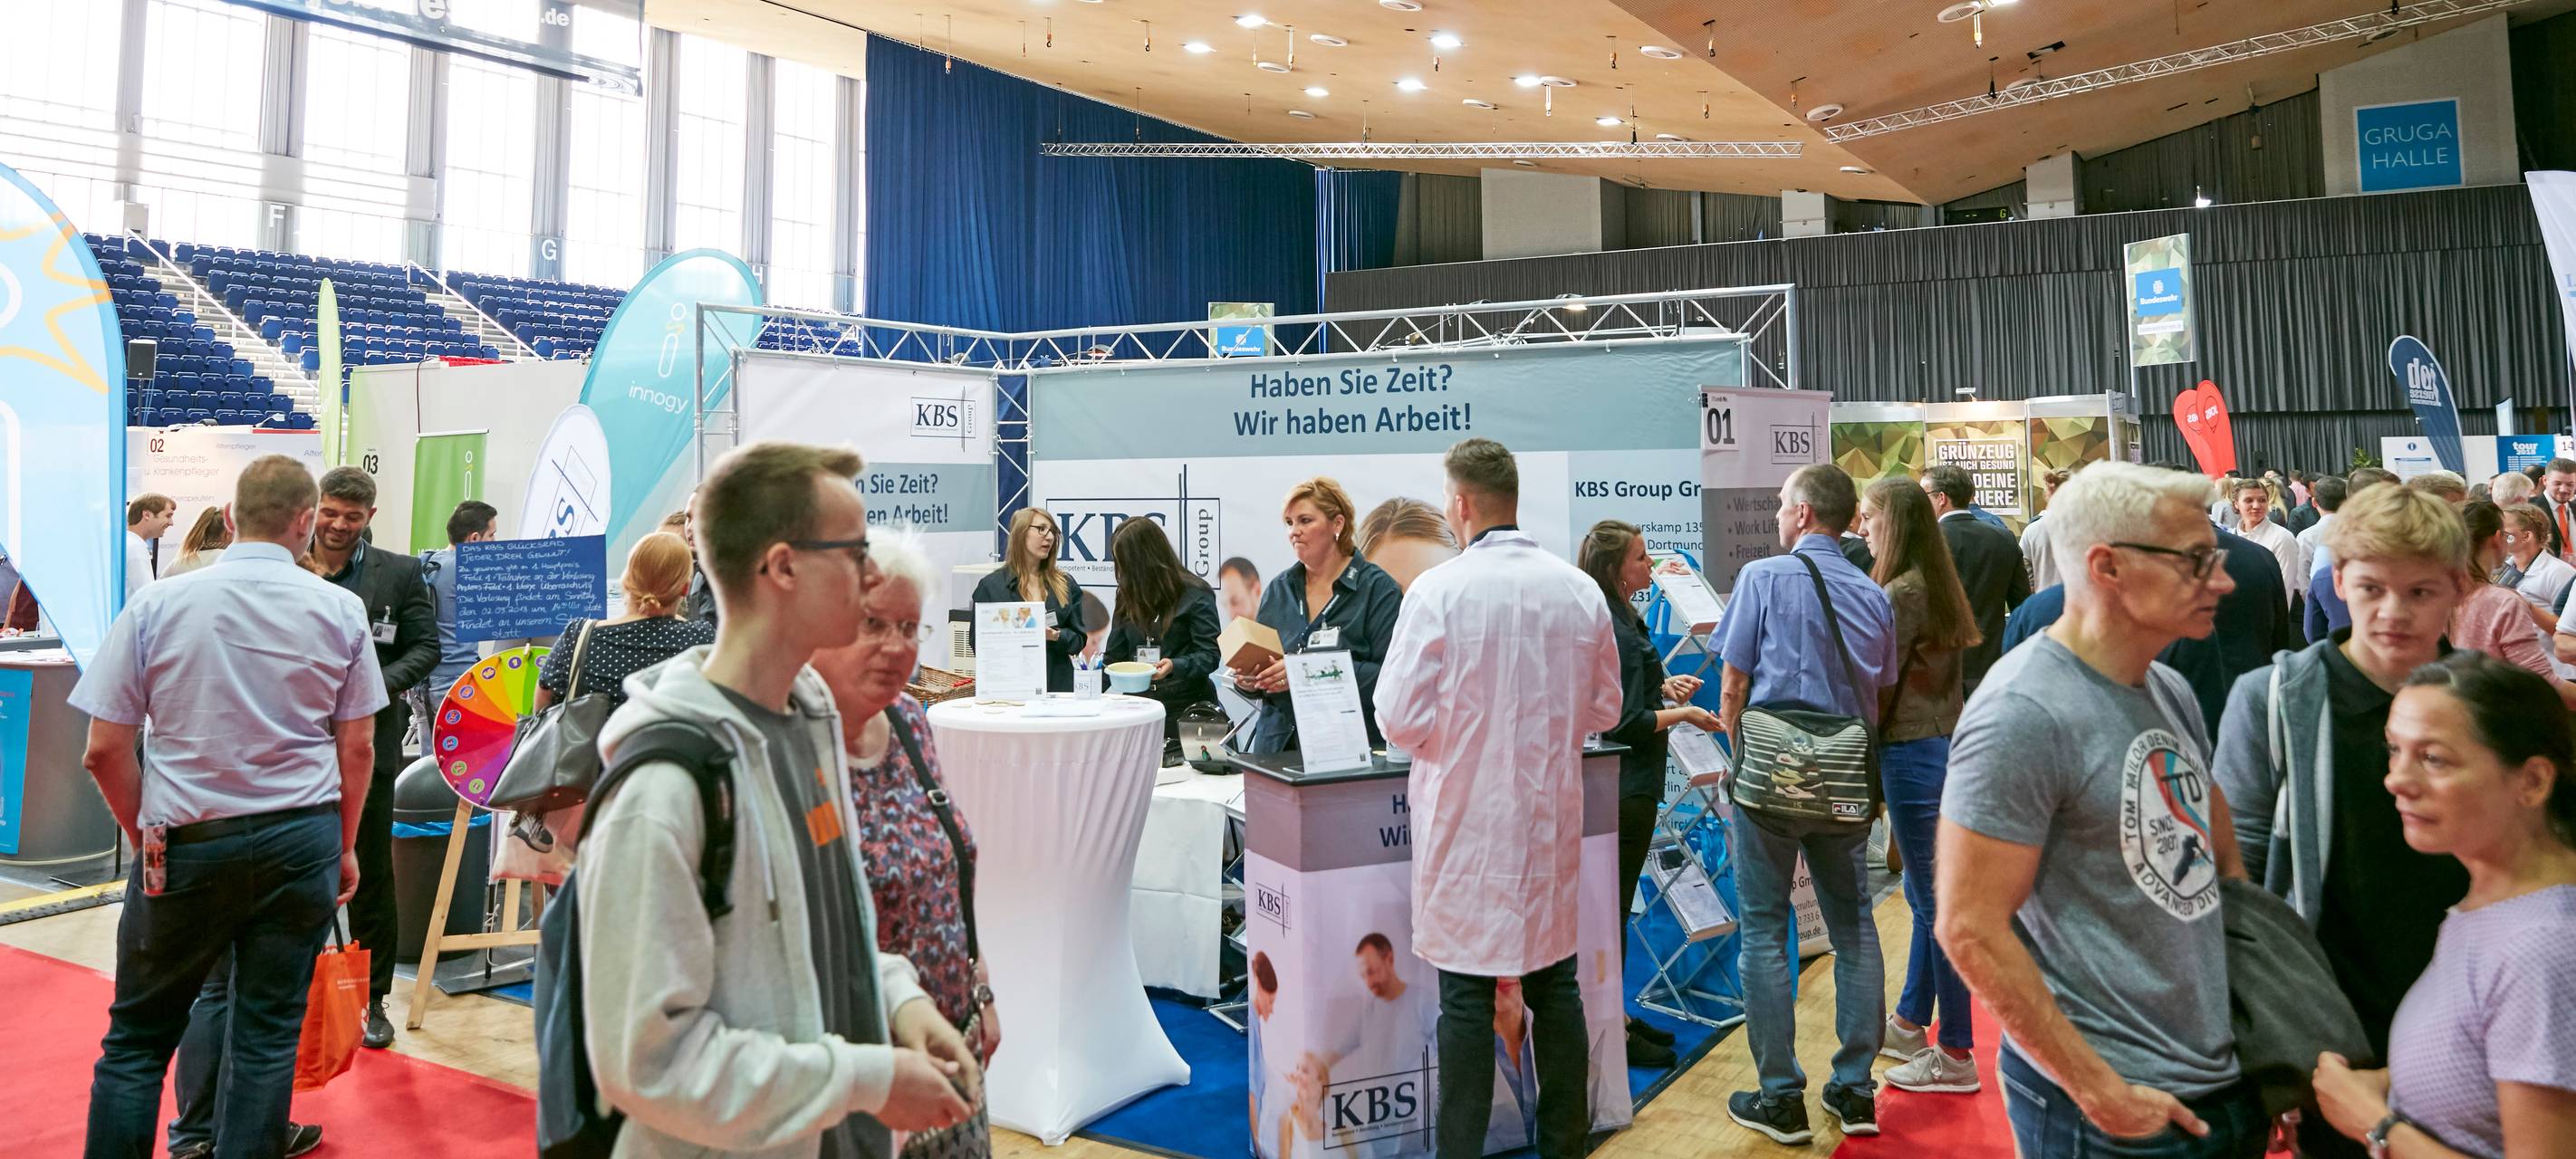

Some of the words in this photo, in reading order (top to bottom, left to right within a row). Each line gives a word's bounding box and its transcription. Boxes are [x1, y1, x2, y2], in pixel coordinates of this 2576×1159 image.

[2365, 123, 2452, 145] GRUGA
[2373, 148, 2448, 169] HALLE
[270, 205, 285, 227] F
[542, 239, 557, 261] G
[2139, 294, 2178, 305] Bundeswehr
[1251, 371, 1331, 398] Haben
[1340, 369, 1378, 395] Sie
[1387, 364, 1453, 393] Zeit?
[628, 381, 688, 414] innogy
[915, 403, 958, 427] KBS
[1234, 410, 1279, 436] Wir
[1286, 407, 1366, 435] haben
[1375, 403, 1471, 433] Arbeit!
[1707, 407, 1735, 445] 01
[149, 438, 165, 453] 02
[1773, 430, 1811, 454] KBS
[1938, 441, 2014, 460] GRÜNZEUG
[362, 455, 379, 474] 03
[1980, 461, 2014, 470] GESUND
[870, 474, 894, 493] Sie
[899, 474, 938, 493] Zeit?
[1575, 482, 1610, 497] KBS
[1615, 481, 1673, 501] Group
[1972, 473, 2016, 488] DEINE
[892, 503, 948, 523] Arbeit!
[1735, 521, 1760, 535] Work
[1195, 508, 1214, 578] Group
[2127, 740, 2148, 790] TAILOR
[1833, 803, 1857, 814] FILA
[2123, 800, 2137, 844] TOM
[1257, 888, 1282, 915] KBS
[1331, 1081, 1418, 1130] KBS
